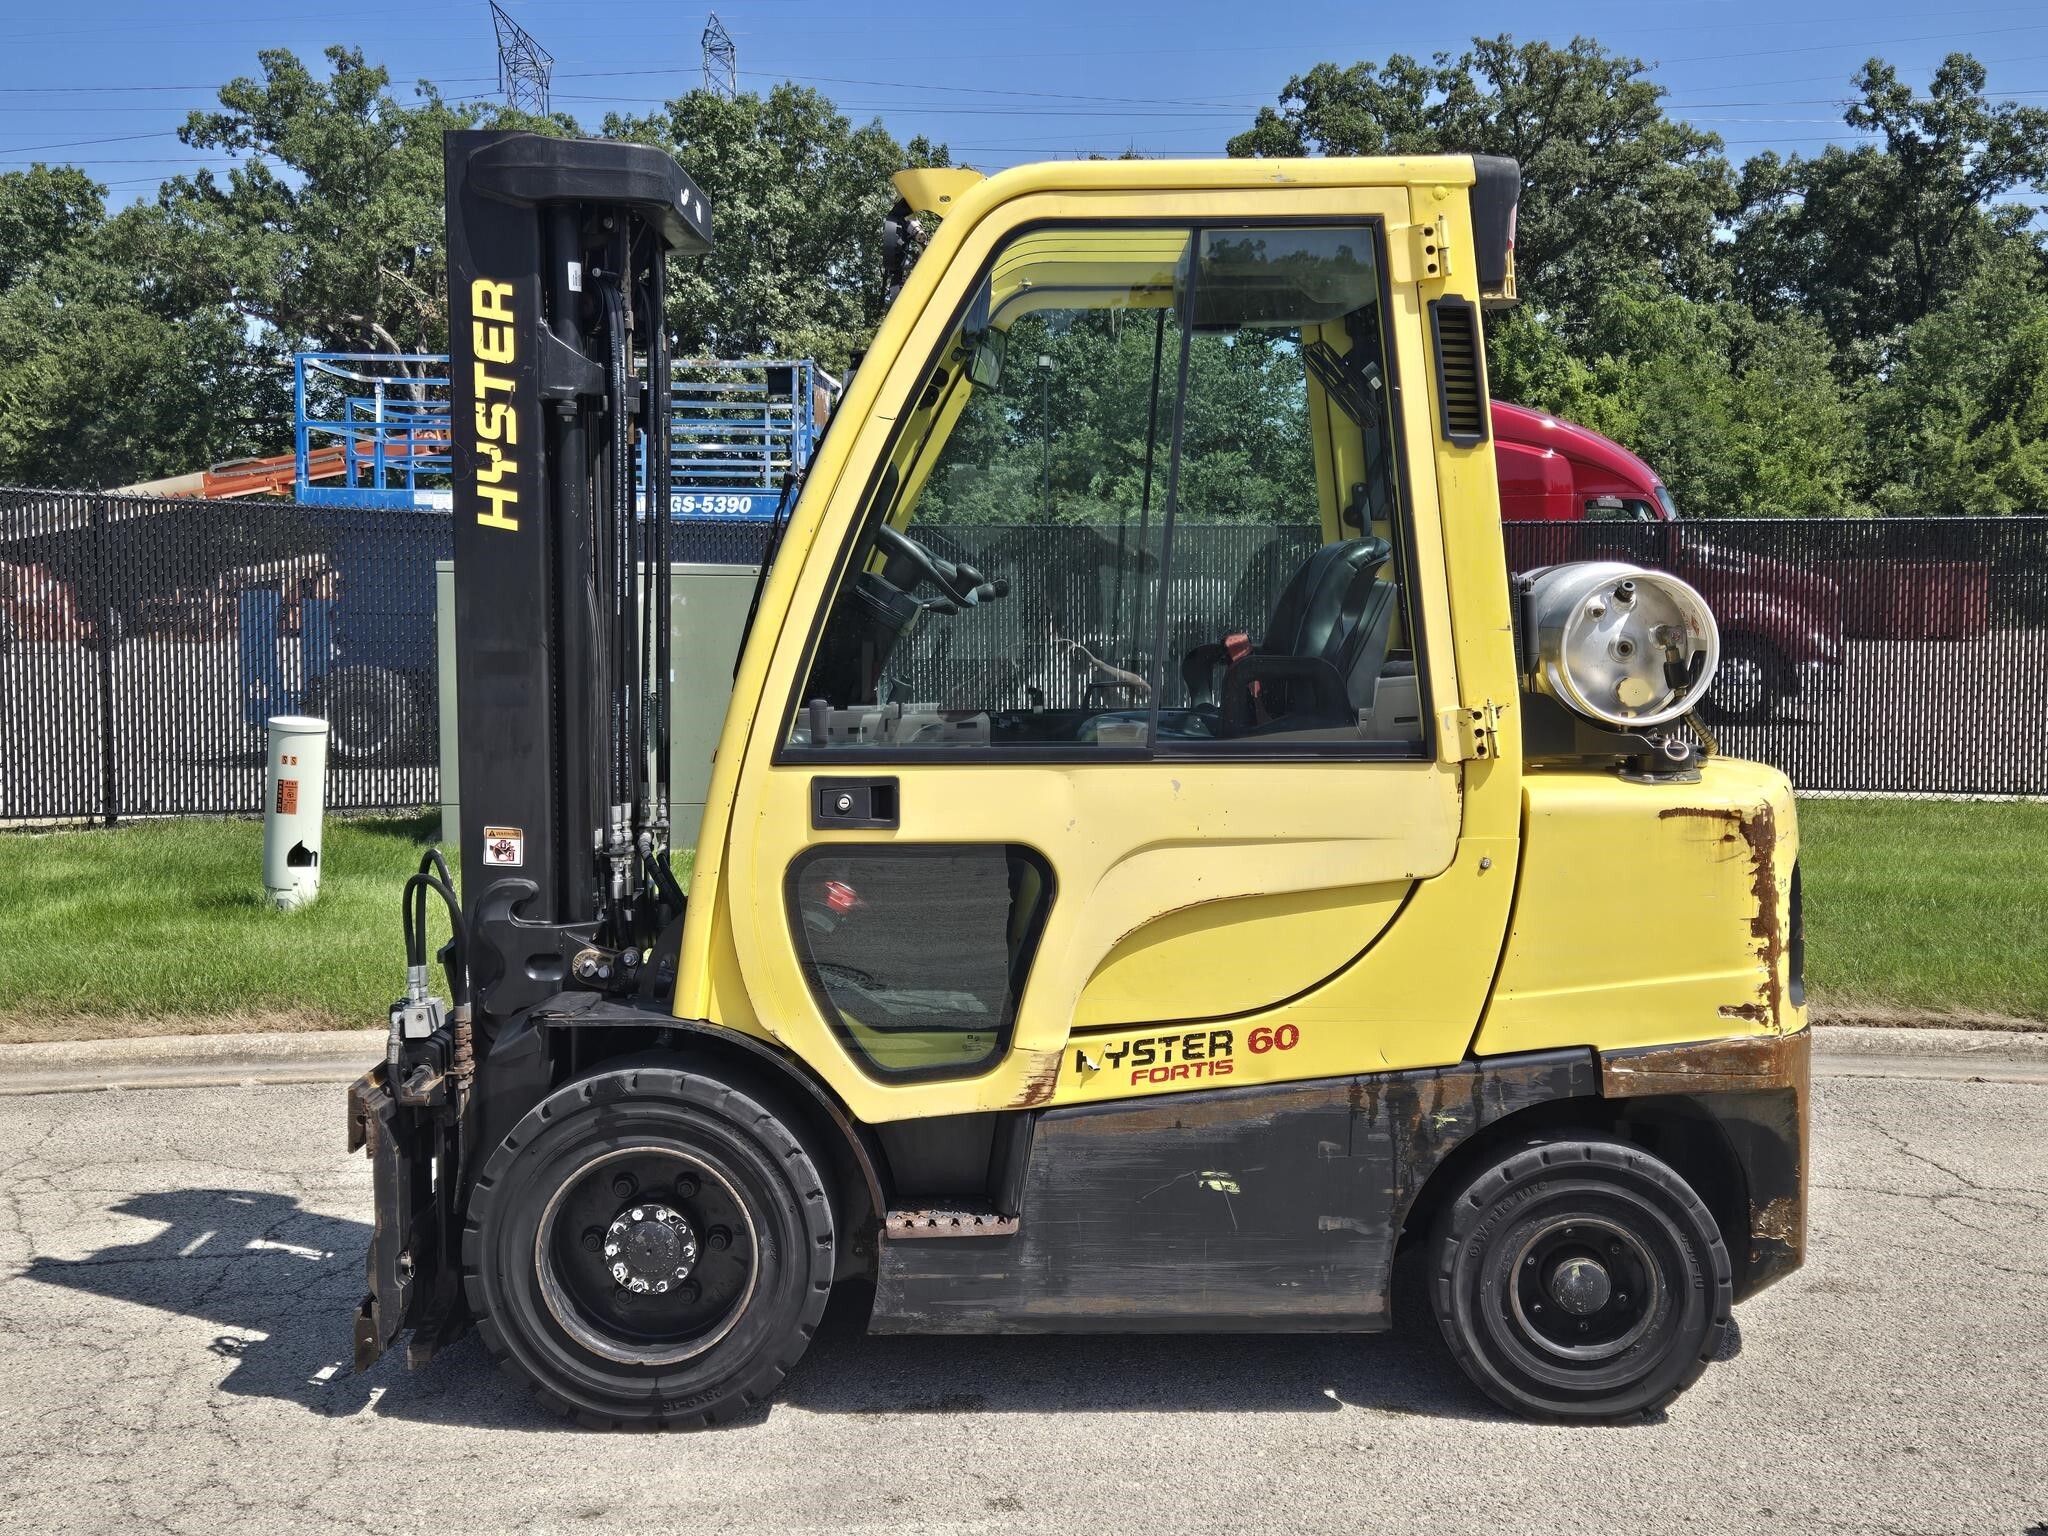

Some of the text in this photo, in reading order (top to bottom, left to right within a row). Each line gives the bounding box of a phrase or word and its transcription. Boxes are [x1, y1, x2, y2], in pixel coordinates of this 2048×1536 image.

[472, 279, 518, 531] HYSTER
[670, 495, 752, 513] GS-5390
[1248, 1024, 1300, 1054] 60
[1130, 1058, 1234, 1086] FORTIS
